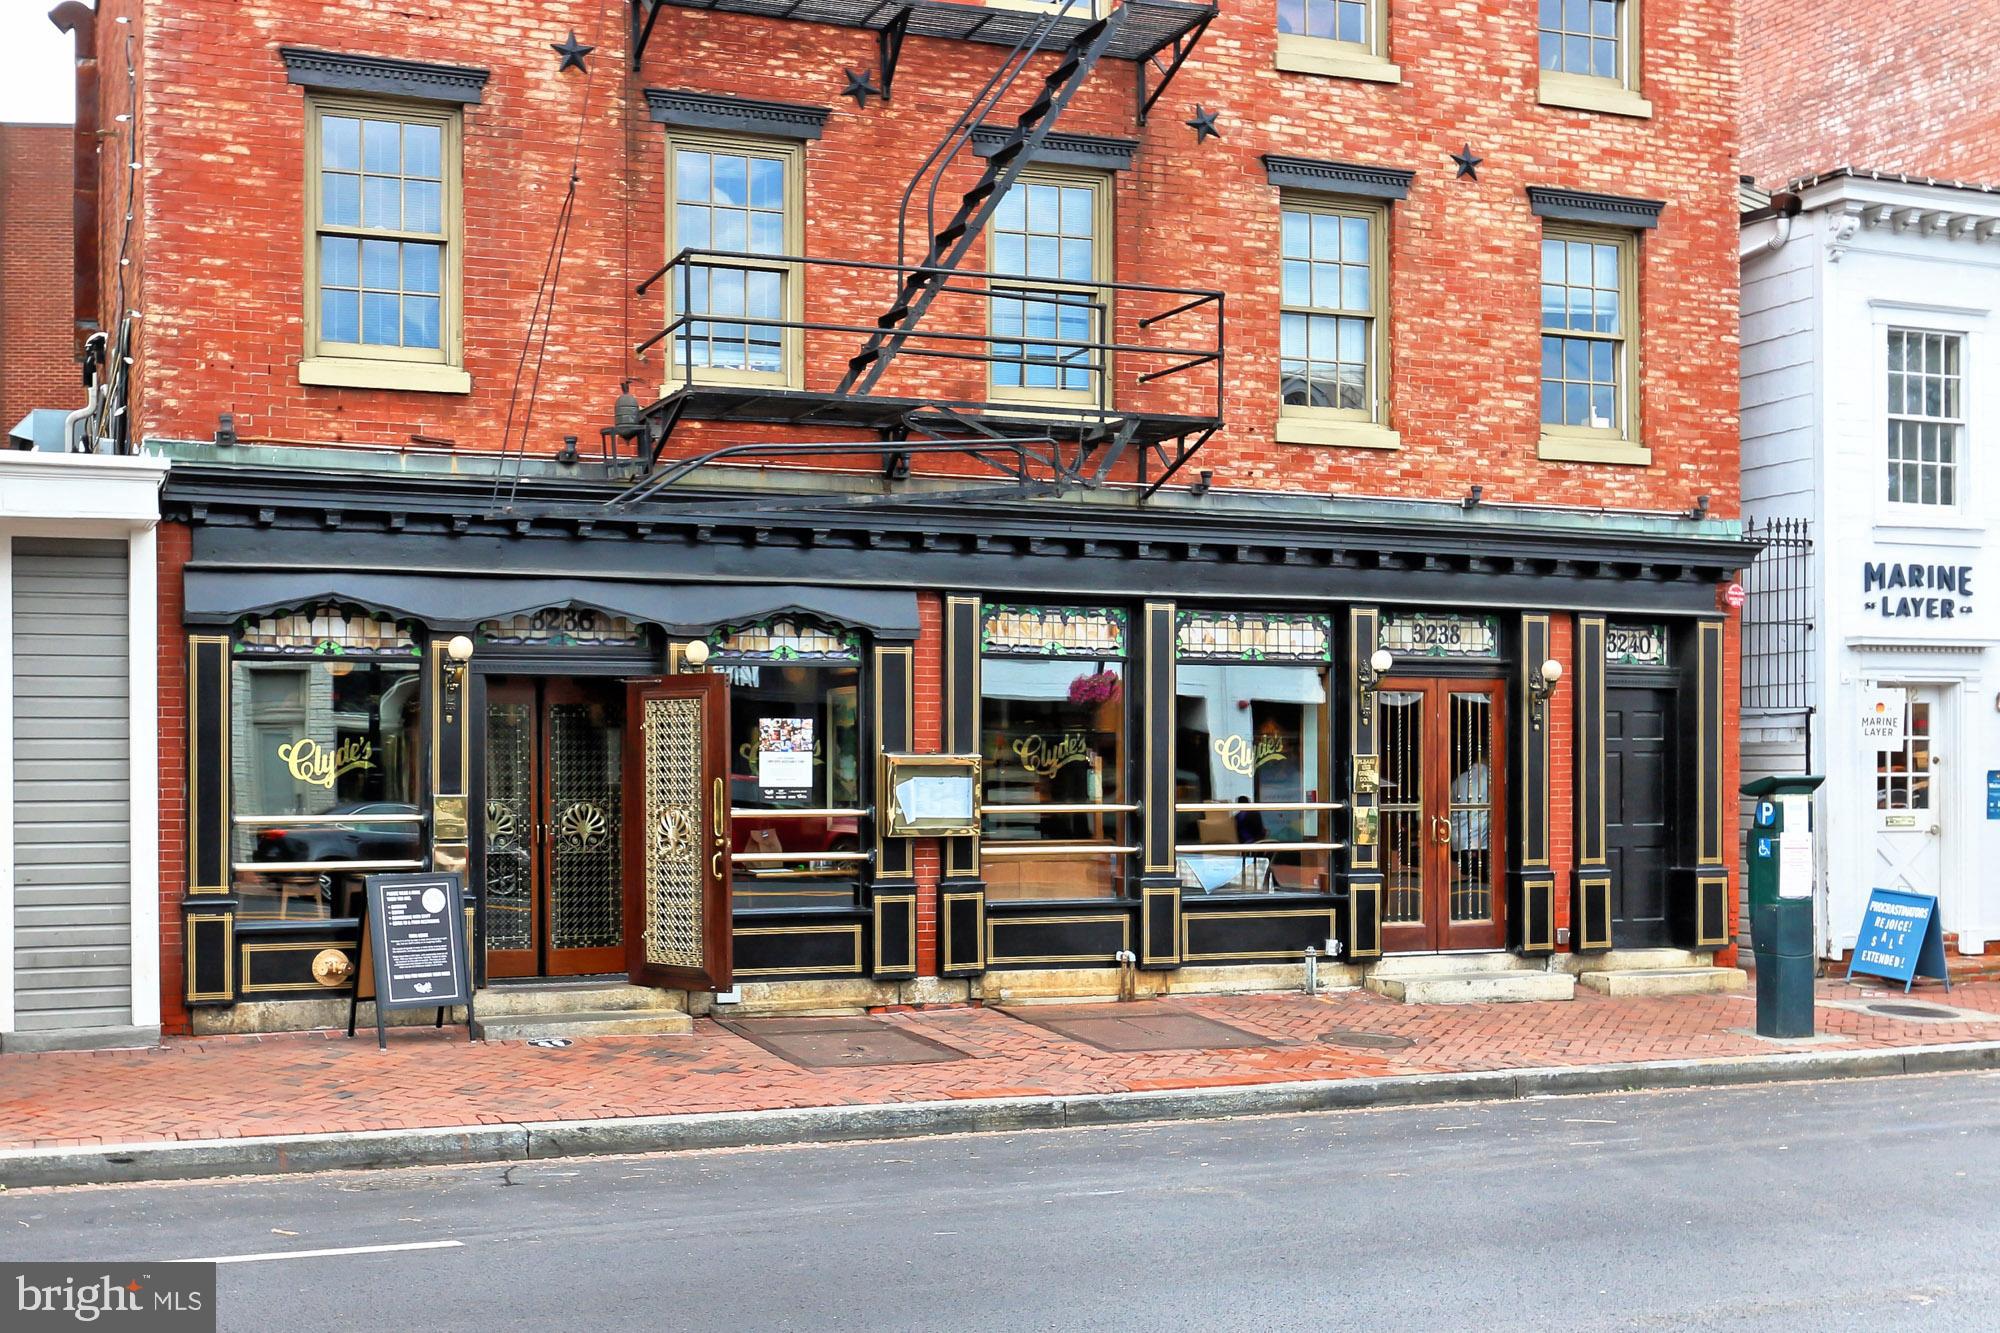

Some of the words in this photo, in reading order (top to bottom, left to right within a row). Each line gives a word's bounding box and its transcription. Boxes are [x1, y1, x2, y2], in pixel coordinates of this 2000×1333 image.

[1864, 561, 1974, 596] MARINE
[1881, 596, 1955, 619] LAYER
[1413, 623, 1461, 645] 3238
[1607, 632, 1651, 654] 3240
[1861, 716, 1898, 728] MARINE
[1864, 727, 1894, 737] LAYER
[277, 736, 376, 790] Clyde's
[1012, 733, 1087, 780] Clyde's
[1214, 733, 1288, 778] Clyde's
[1761, 802, 1774, 825] P
[1869, 900, 1930, 919] PROCRASTINATORS
[1874, 916, 1913, 932] REJOICE!
[1870, 931, 1905, 950] SALE
[1861, 950, 1905, 969] EXTENDED!
